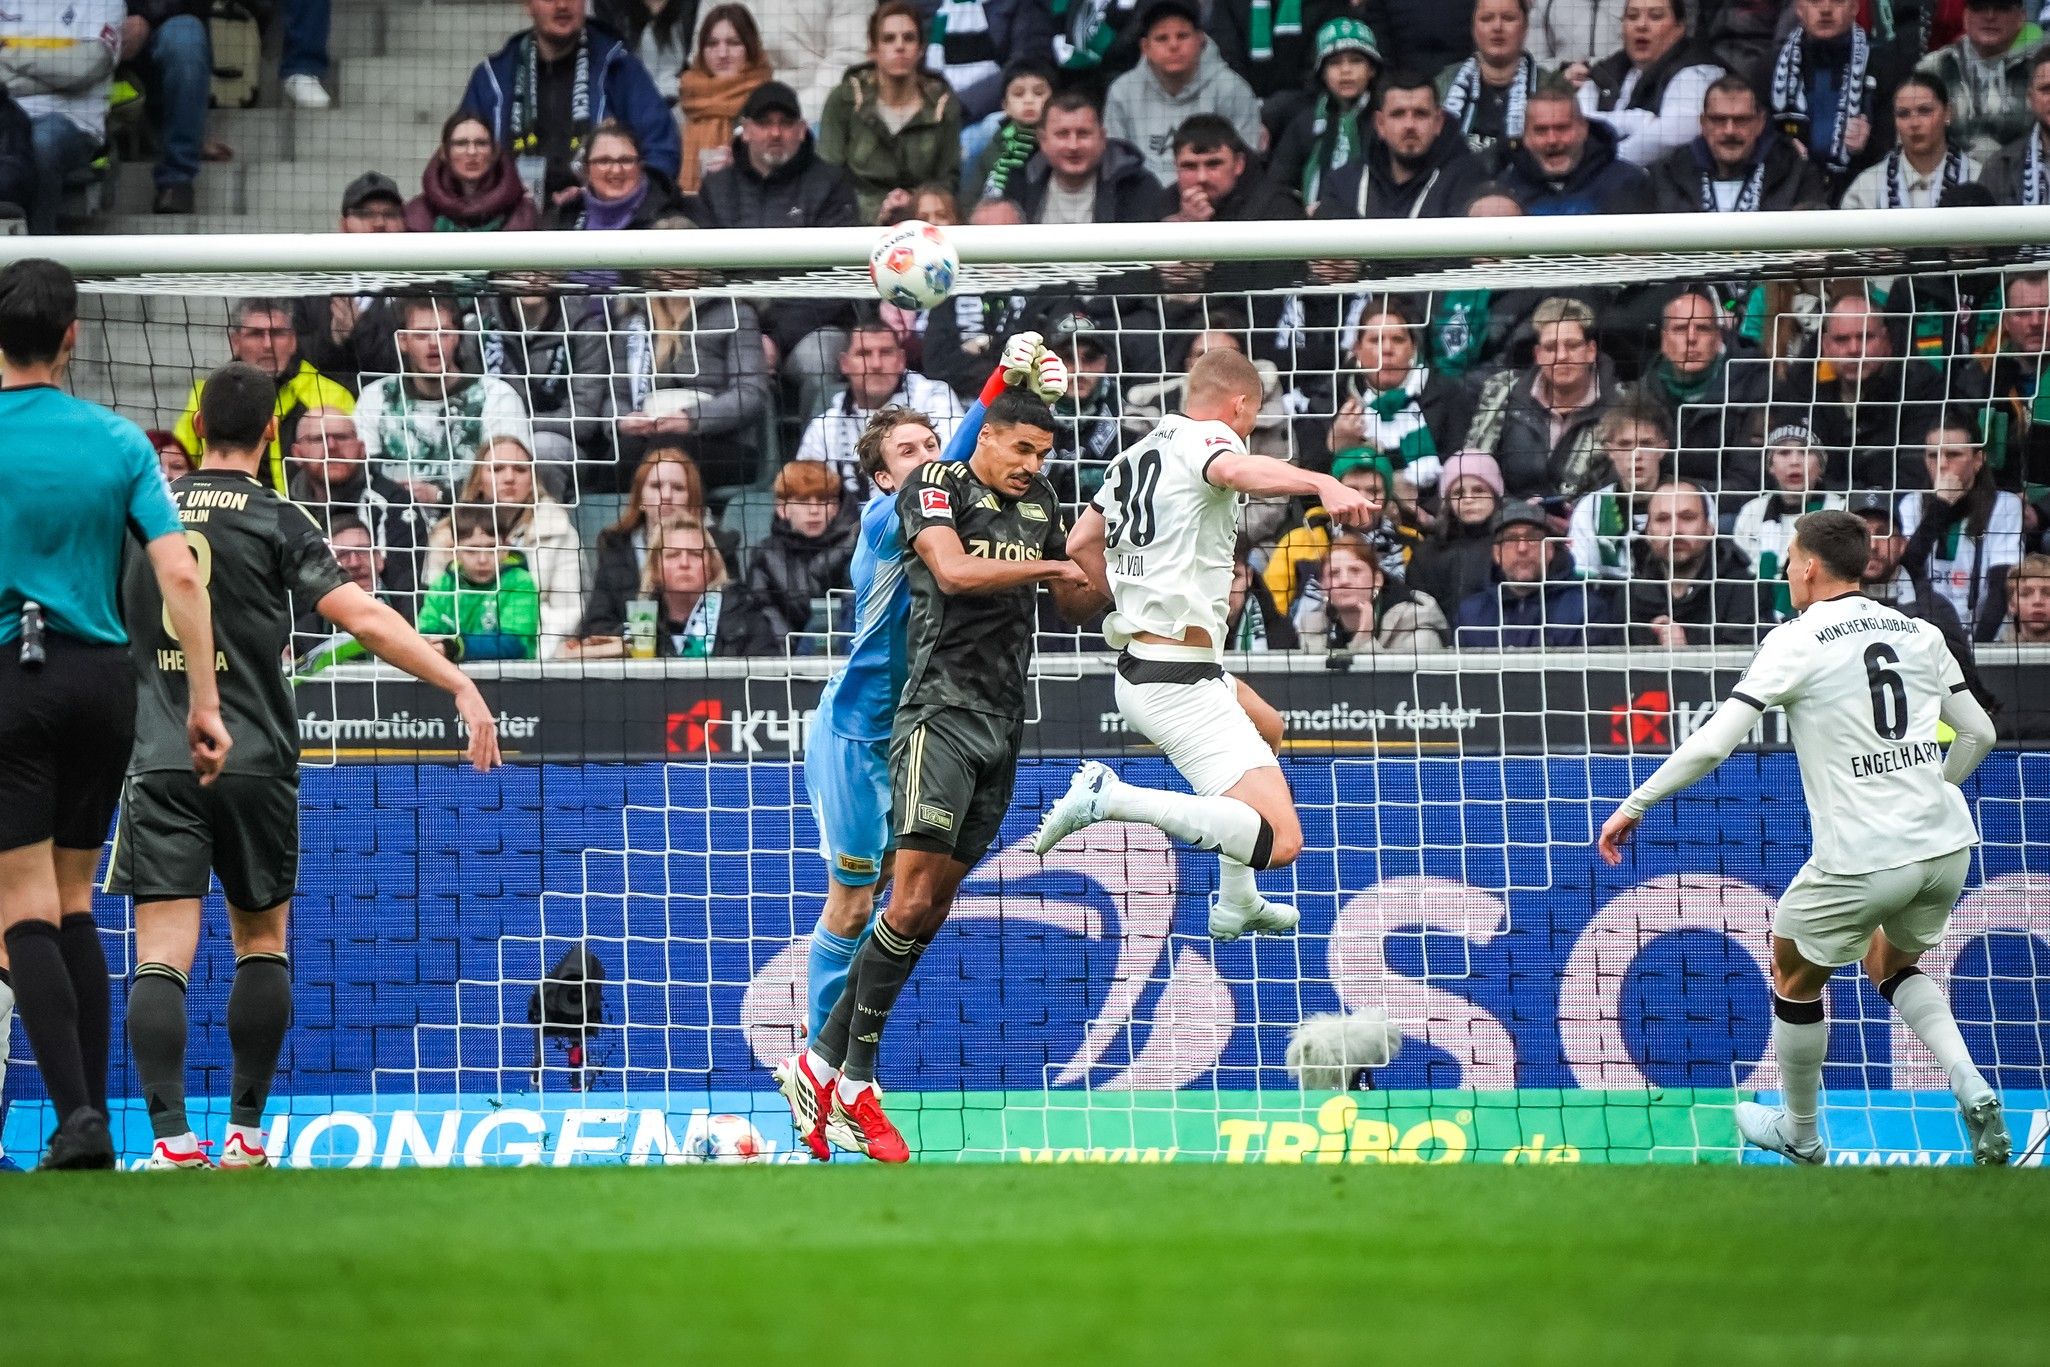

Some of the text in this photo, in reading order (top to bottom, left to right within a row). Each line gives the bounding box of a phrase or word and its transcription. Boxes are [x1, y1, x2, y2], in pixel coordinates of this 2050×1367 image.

[186, 490, 249, 511] UNION
[1105, 449, 1162, 548] 30
[177, 509, 210, 523] ERLIN
[1815, 617, 1920, 645] MÖNCHENGLADBACH
[1863, 642, 1908, 741] 6
[298, 711, 541, 740] formation fter
[1395, 701, 1482, 731] faster
